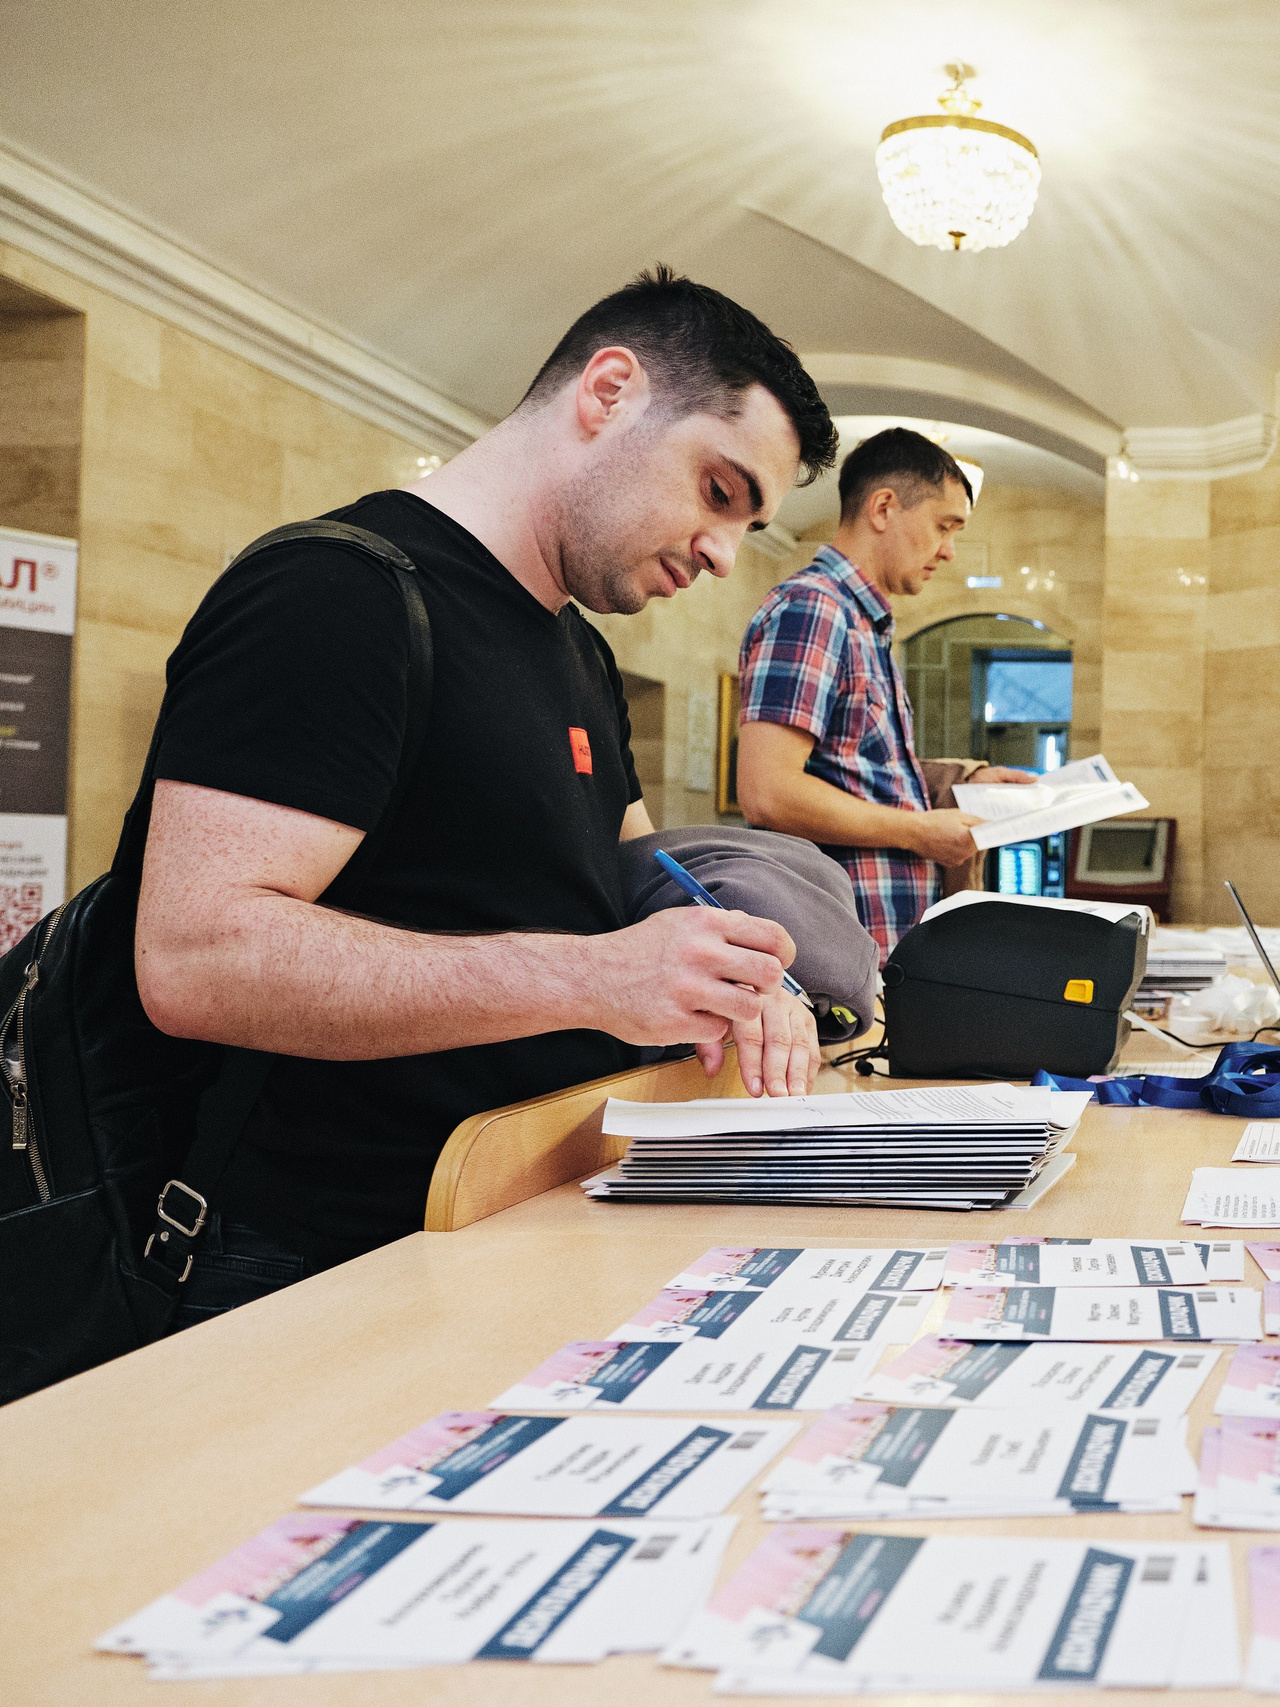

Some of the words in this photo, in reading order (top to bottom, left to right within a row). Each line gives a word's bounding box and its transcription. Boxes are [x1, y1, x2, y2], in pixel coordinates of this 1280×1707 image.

[881, 1256, 915, 1287] ДОКЛАДЧИК
[1088, 1258, 1100, 1271] Сергей
[1141, 1251, 1166, 1282] ДОКЛАДЧИК
[846, 1300, 886, 1340] ДОКЛАДЧИК
[1168, 1296, 1193, 1334] ДОКЛАДЧИК
[768, 1354, 820, 1404] ДОКЛАДЧИК
[622, 1437, 718, 1509] ДОКЛАДЧИК
[1072, 1425, 1116, 1492] ДОКЛАДЧИК
